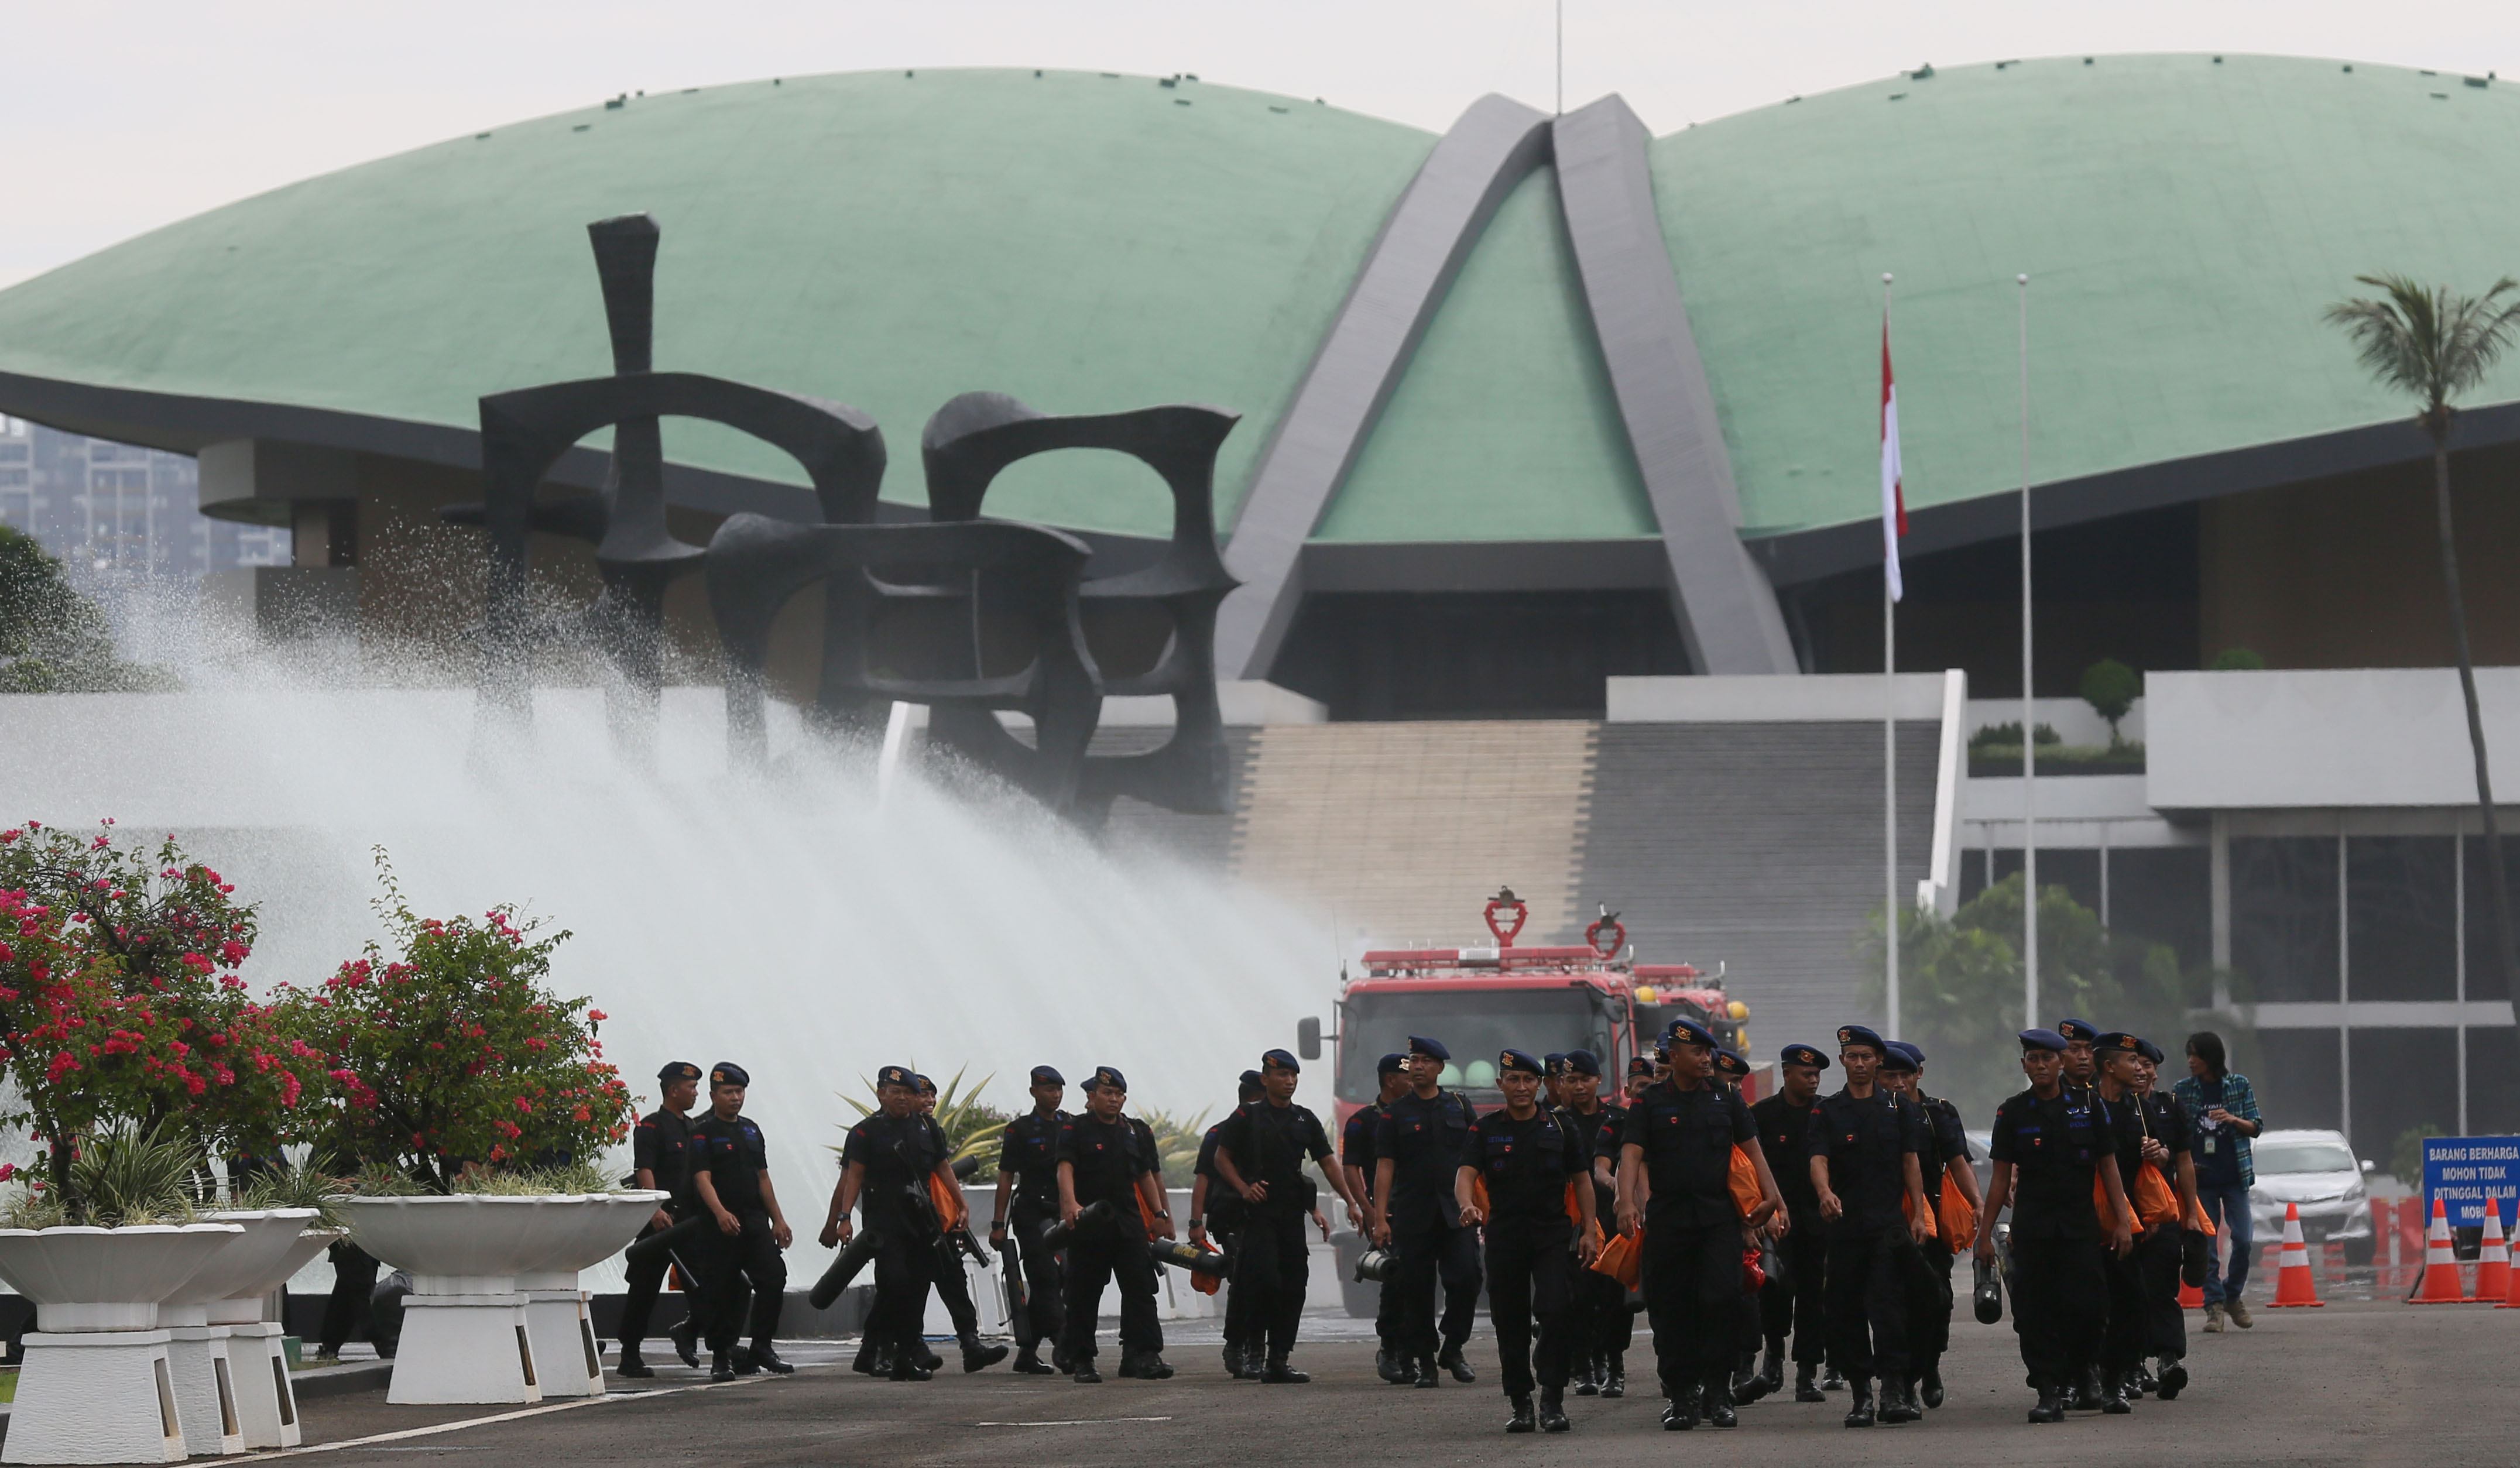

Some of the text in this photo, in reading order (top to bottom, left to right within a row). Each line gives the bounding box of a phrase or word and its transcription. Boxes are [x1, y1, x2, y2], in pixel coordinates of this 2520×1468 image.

[2429, 1147, 2519, 1161] BARANG BERHARGA
[2442, 1166, 2506, 1181] MOHON TIDAK
[2434, 1185, 2516, 1200] DITINGGAL DALAM
